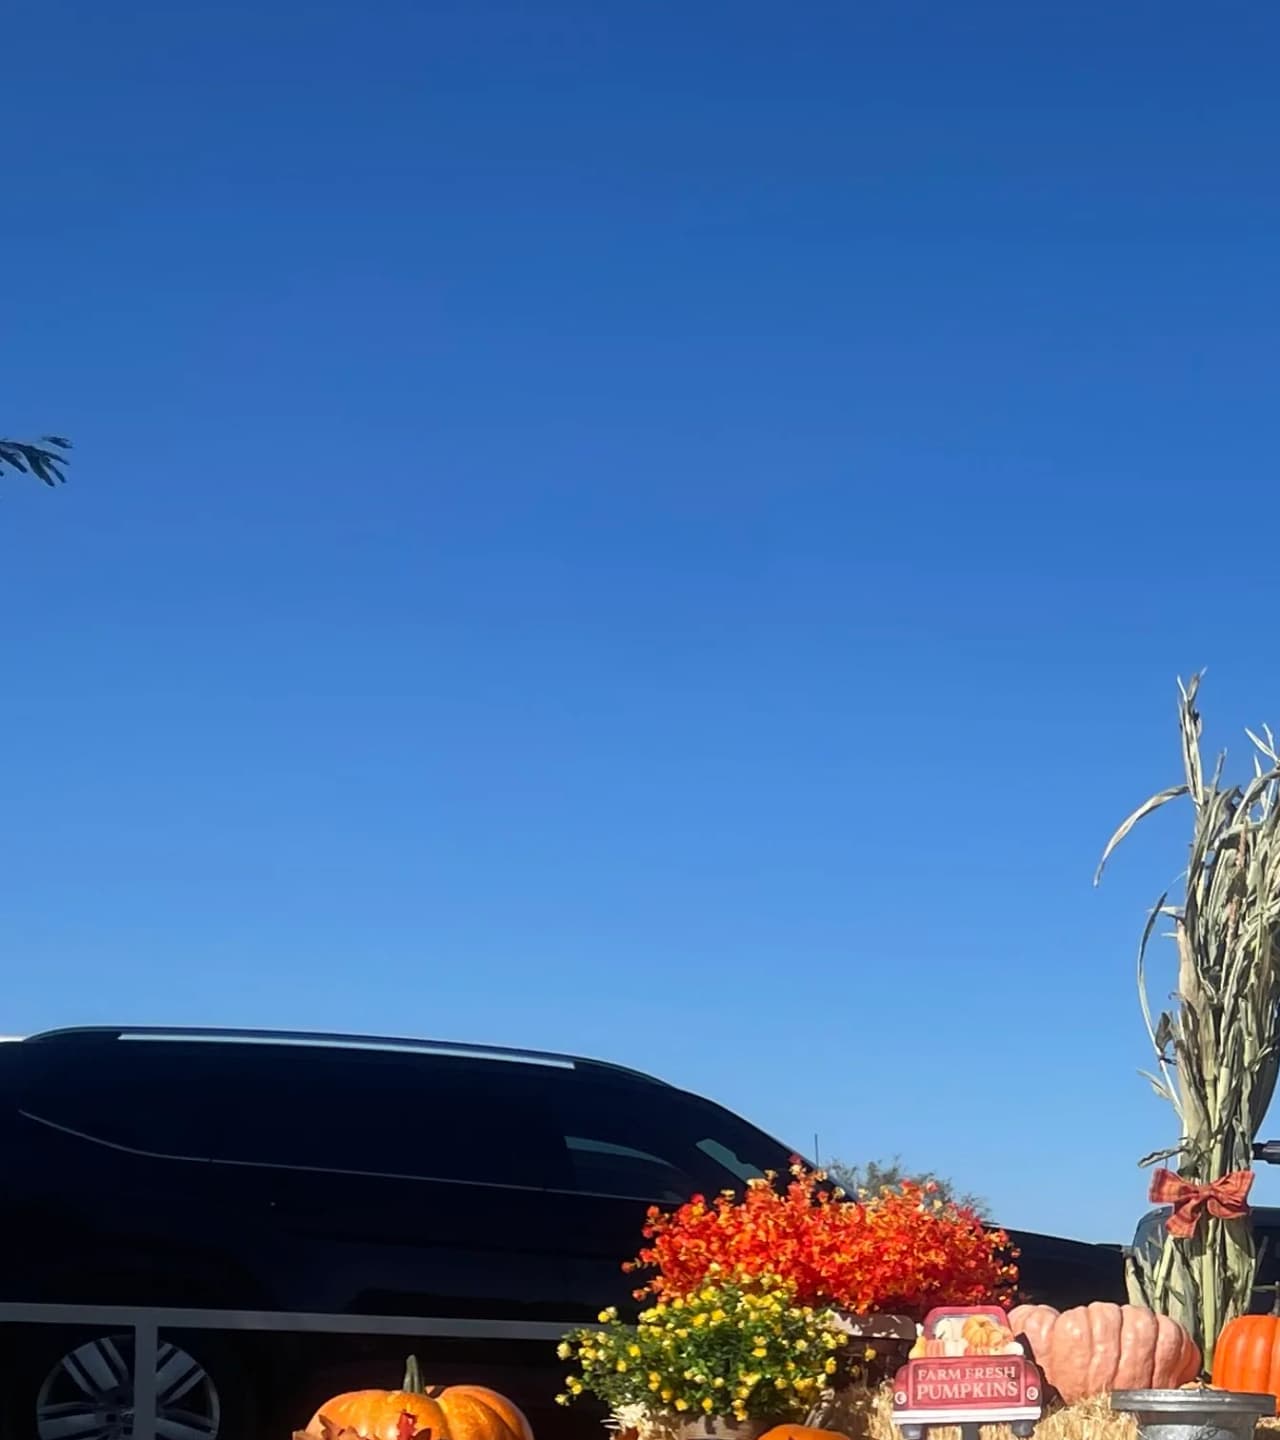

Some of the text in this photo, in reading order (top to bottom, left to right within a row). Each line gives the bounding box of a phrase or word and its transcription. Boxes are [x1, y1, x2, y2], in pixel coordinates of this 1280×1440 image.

[918, 1366, 1016, 1380] FARM FRESH
[917, 1381, 1018, 1400] PUMPKINS
